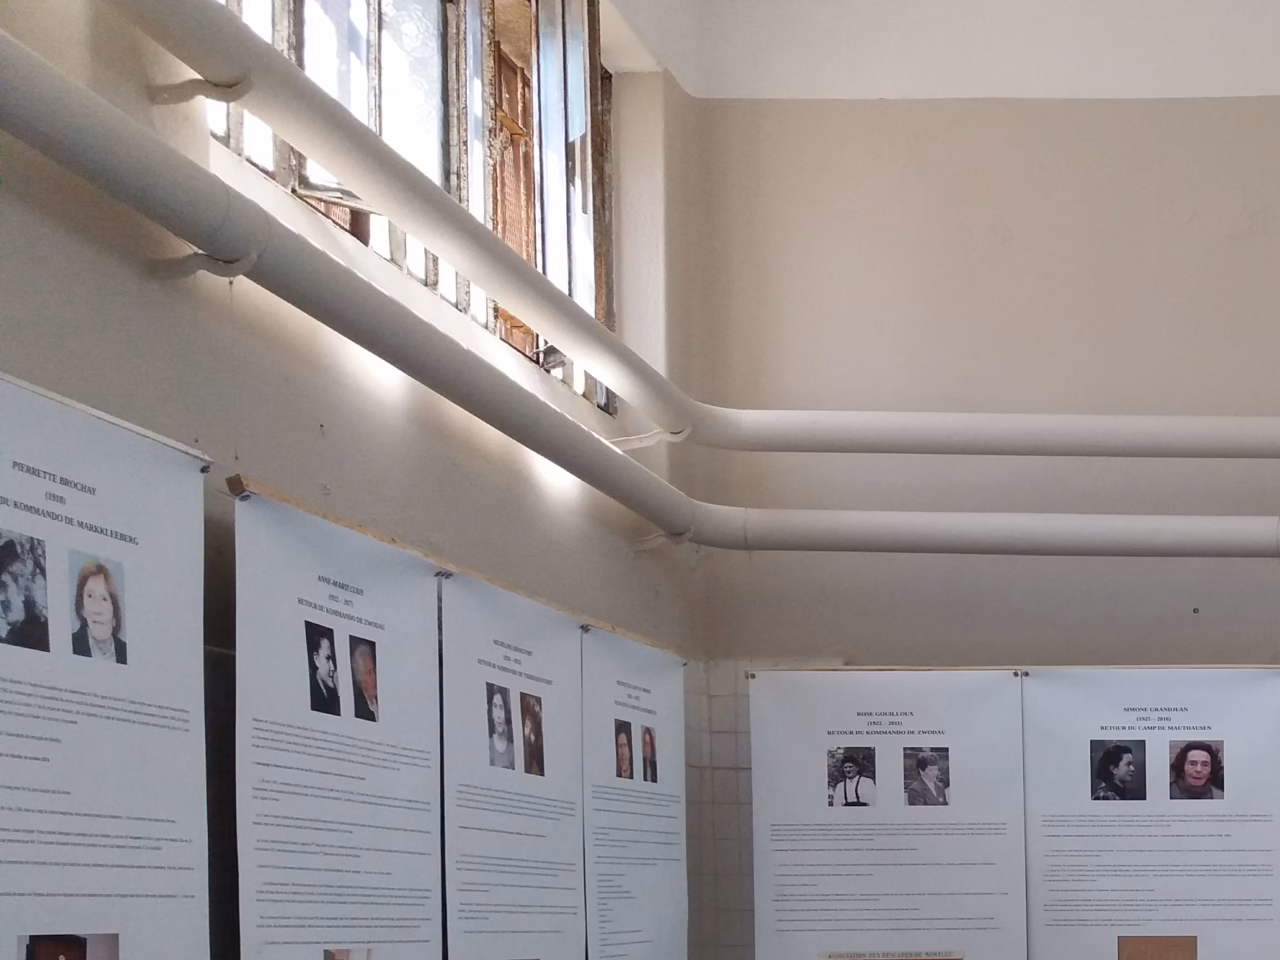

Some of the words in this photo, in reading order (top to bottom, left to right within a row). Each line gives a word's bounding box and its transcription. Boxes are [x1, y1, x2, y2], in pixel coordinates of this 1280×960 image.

[12, 461, 58, 483] PIERRETTE
[59, 477, 97, 496] BROCHAY
[45, 491, 67, 505] (1918)
[13, 500, 64, 523] KOMMANDO
[64, 515, 76, 527] DE
[76, 519, 139, 546] MARKKLEEBERG
[317, 575, 350, 592] ANNE-MARIE
[297, 597, 319, 611] RETOUR
[318, 604, 326, 613] DU
[325, 607, 356, 623] KOMMANDO
[355, 616, 364, 625] DE
